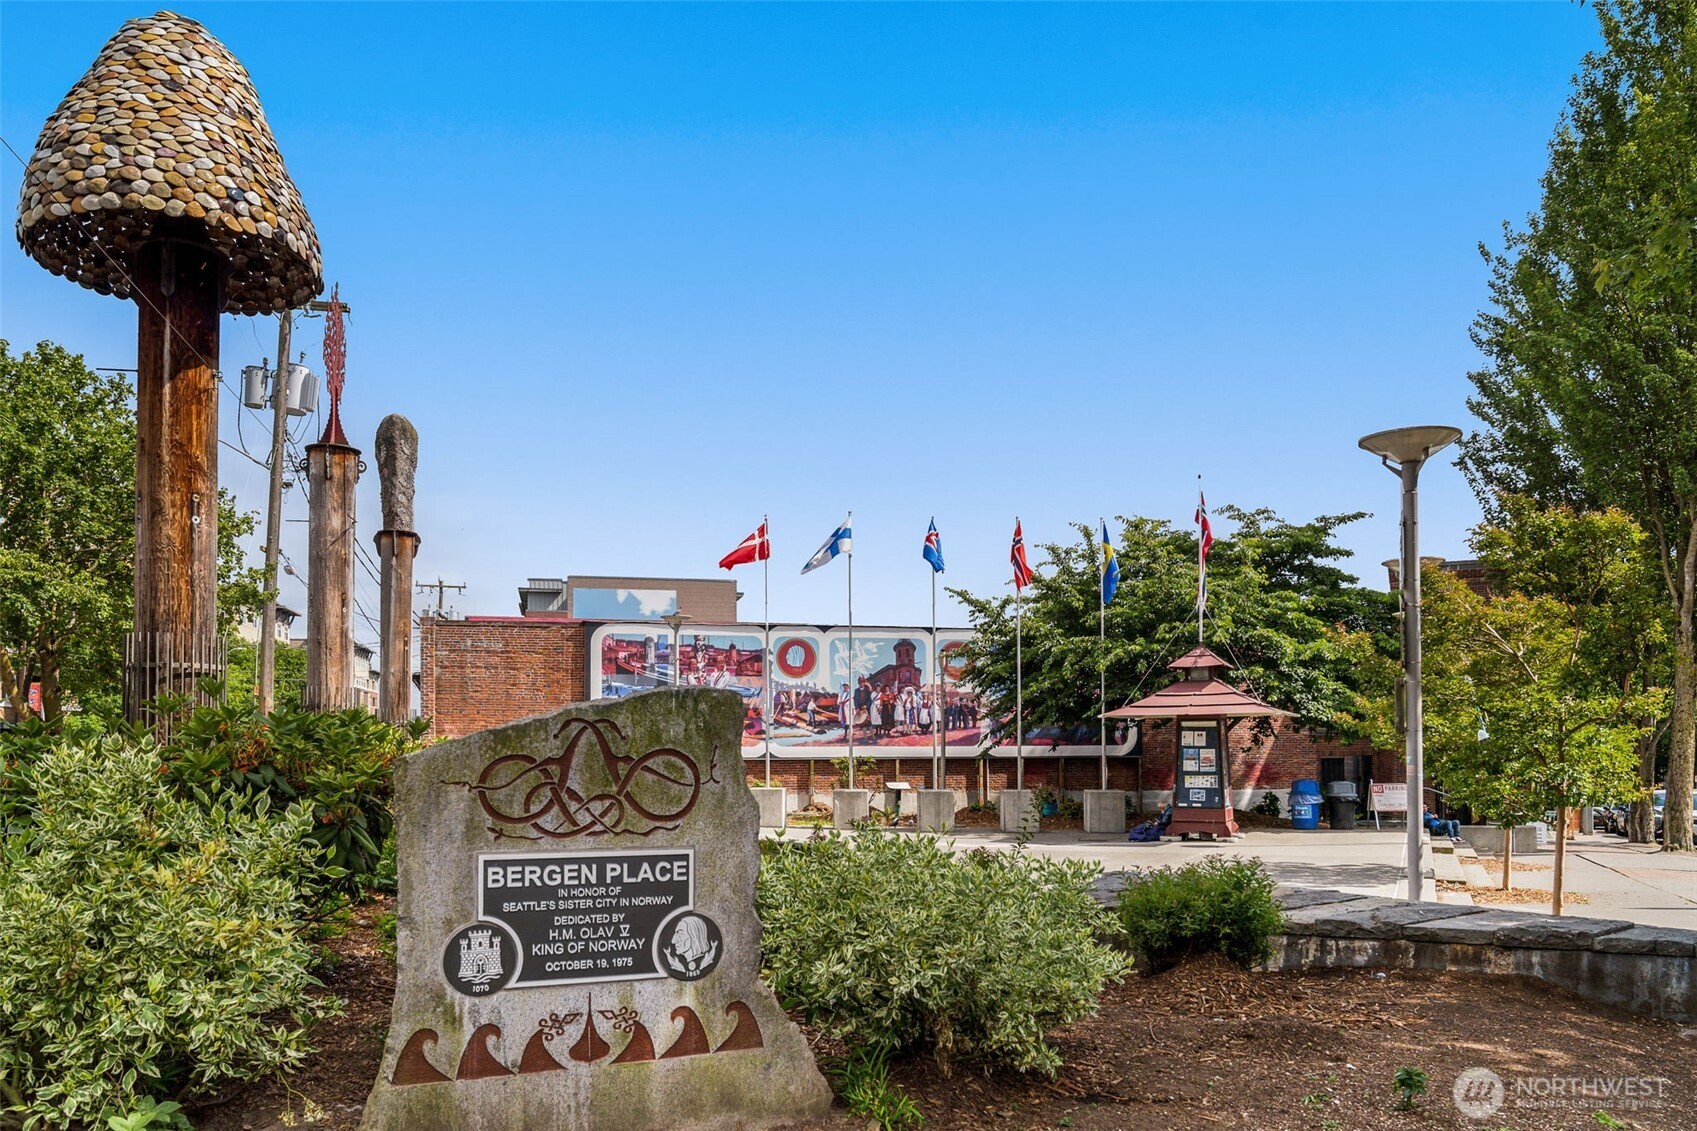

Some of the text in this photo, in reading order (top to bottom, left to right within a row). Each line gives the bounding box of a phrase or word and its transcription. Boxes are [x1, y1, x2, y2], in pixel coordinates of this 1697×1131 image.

[487, 861, 688, 888] BERGEN PLACE
[558, 886, 622, 898] IN HONOR OF
[502, 896, 673, 912] SEATTLE'S SISTER CITY IN NORWAY
[554, 913, 626, 926] DEDICATED BY
[549, 928, 577, 940] H.M.
[580, 926, 614, 938] OLAV
[532, 938, 646, 956] KING OF NORWAY
[545, 958, 633, 972] OCTOBER 19, 1975
[472, 984, 490, 992] 1070
